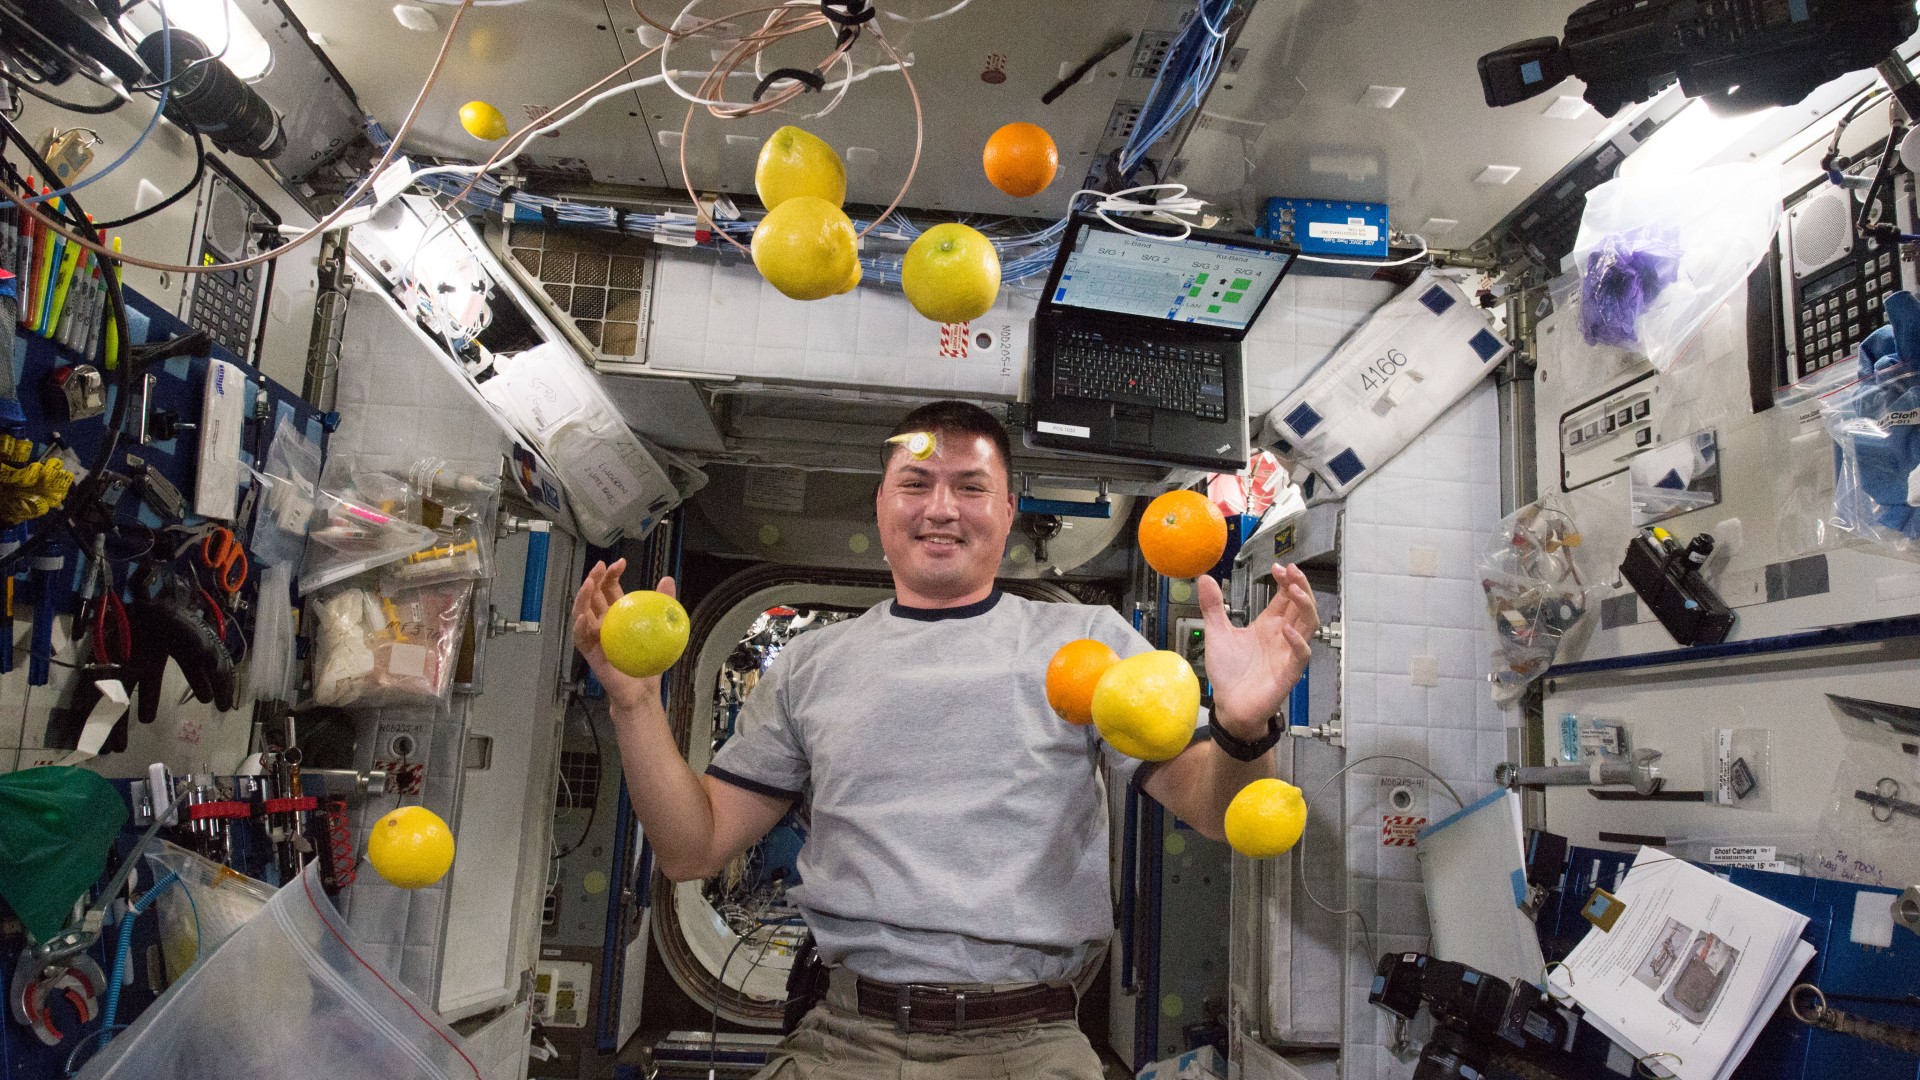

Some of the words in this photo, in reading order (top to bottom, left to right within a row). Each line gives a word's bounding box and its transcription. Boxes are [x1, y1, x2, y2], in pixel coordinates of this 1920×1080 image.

[1123, 240, 1152, 249] S-Band
[1098, 248, 1116, 256] S/G
[1141, 254, 1161, 263] S/G
[1216, 253, 1249, 263] Ku-Band
[1192, 261, 1209, 269] S/G
[1235, 267, 1253, 276] S/G
[1361, 348, 1407, 391] 4166
[1890, 410, 1918, 420] Cloth
[1714, 847, 1731, 855] Ghost
[1732, 847, 1757, 855] Camera
